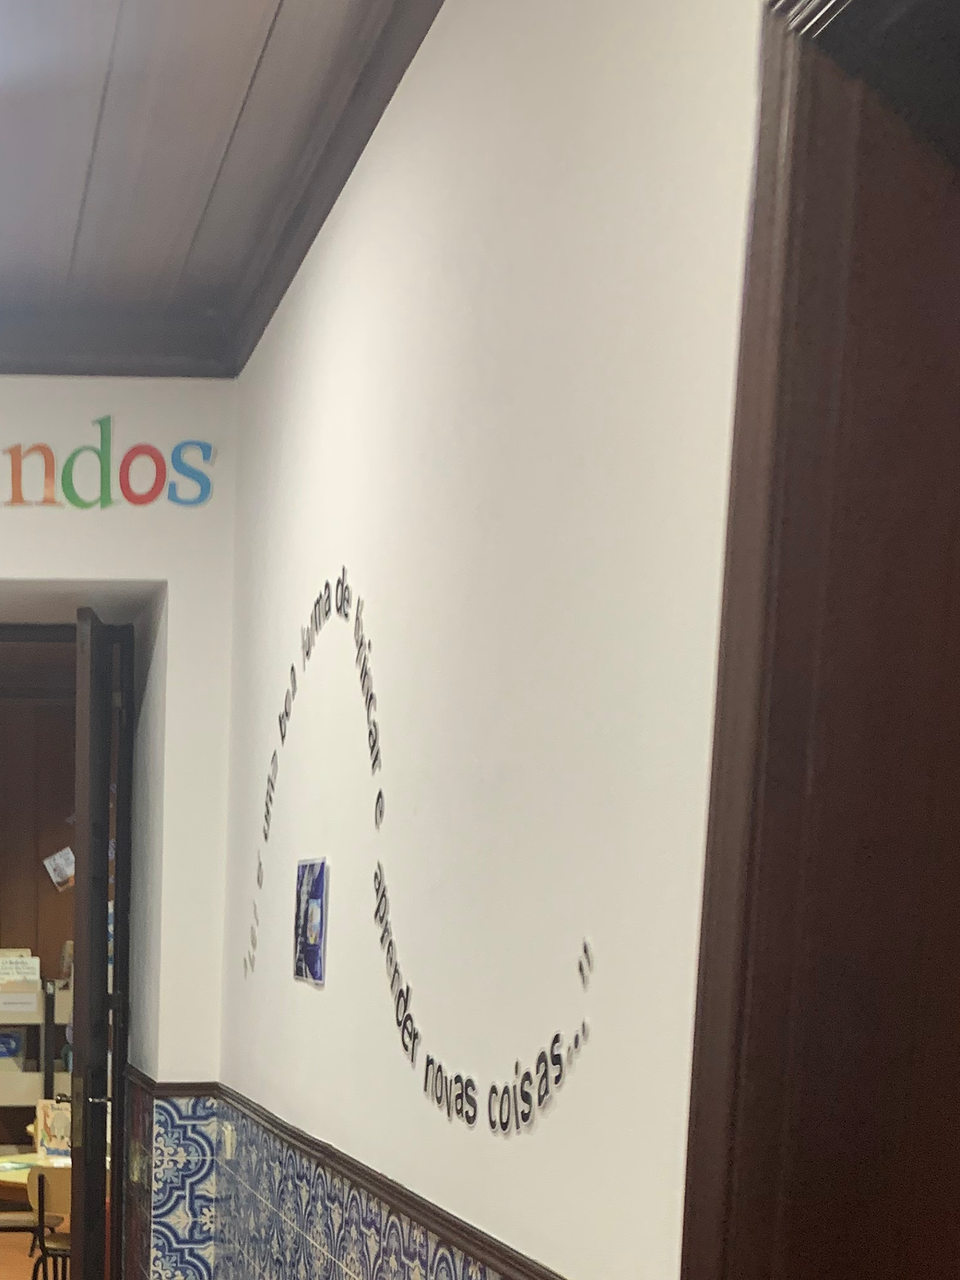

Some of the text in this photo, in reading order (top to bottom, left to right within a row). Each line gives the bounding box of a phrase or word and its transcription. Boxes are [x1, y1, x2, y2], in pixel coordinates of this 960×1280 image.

[335, 565, 351, 621] de
[354, 595, 381, 776] brincar
[374, 787, 385, 832] e
[373, 861, 420, 1064] aprender
[423, 1053, 477, 1127] novas
